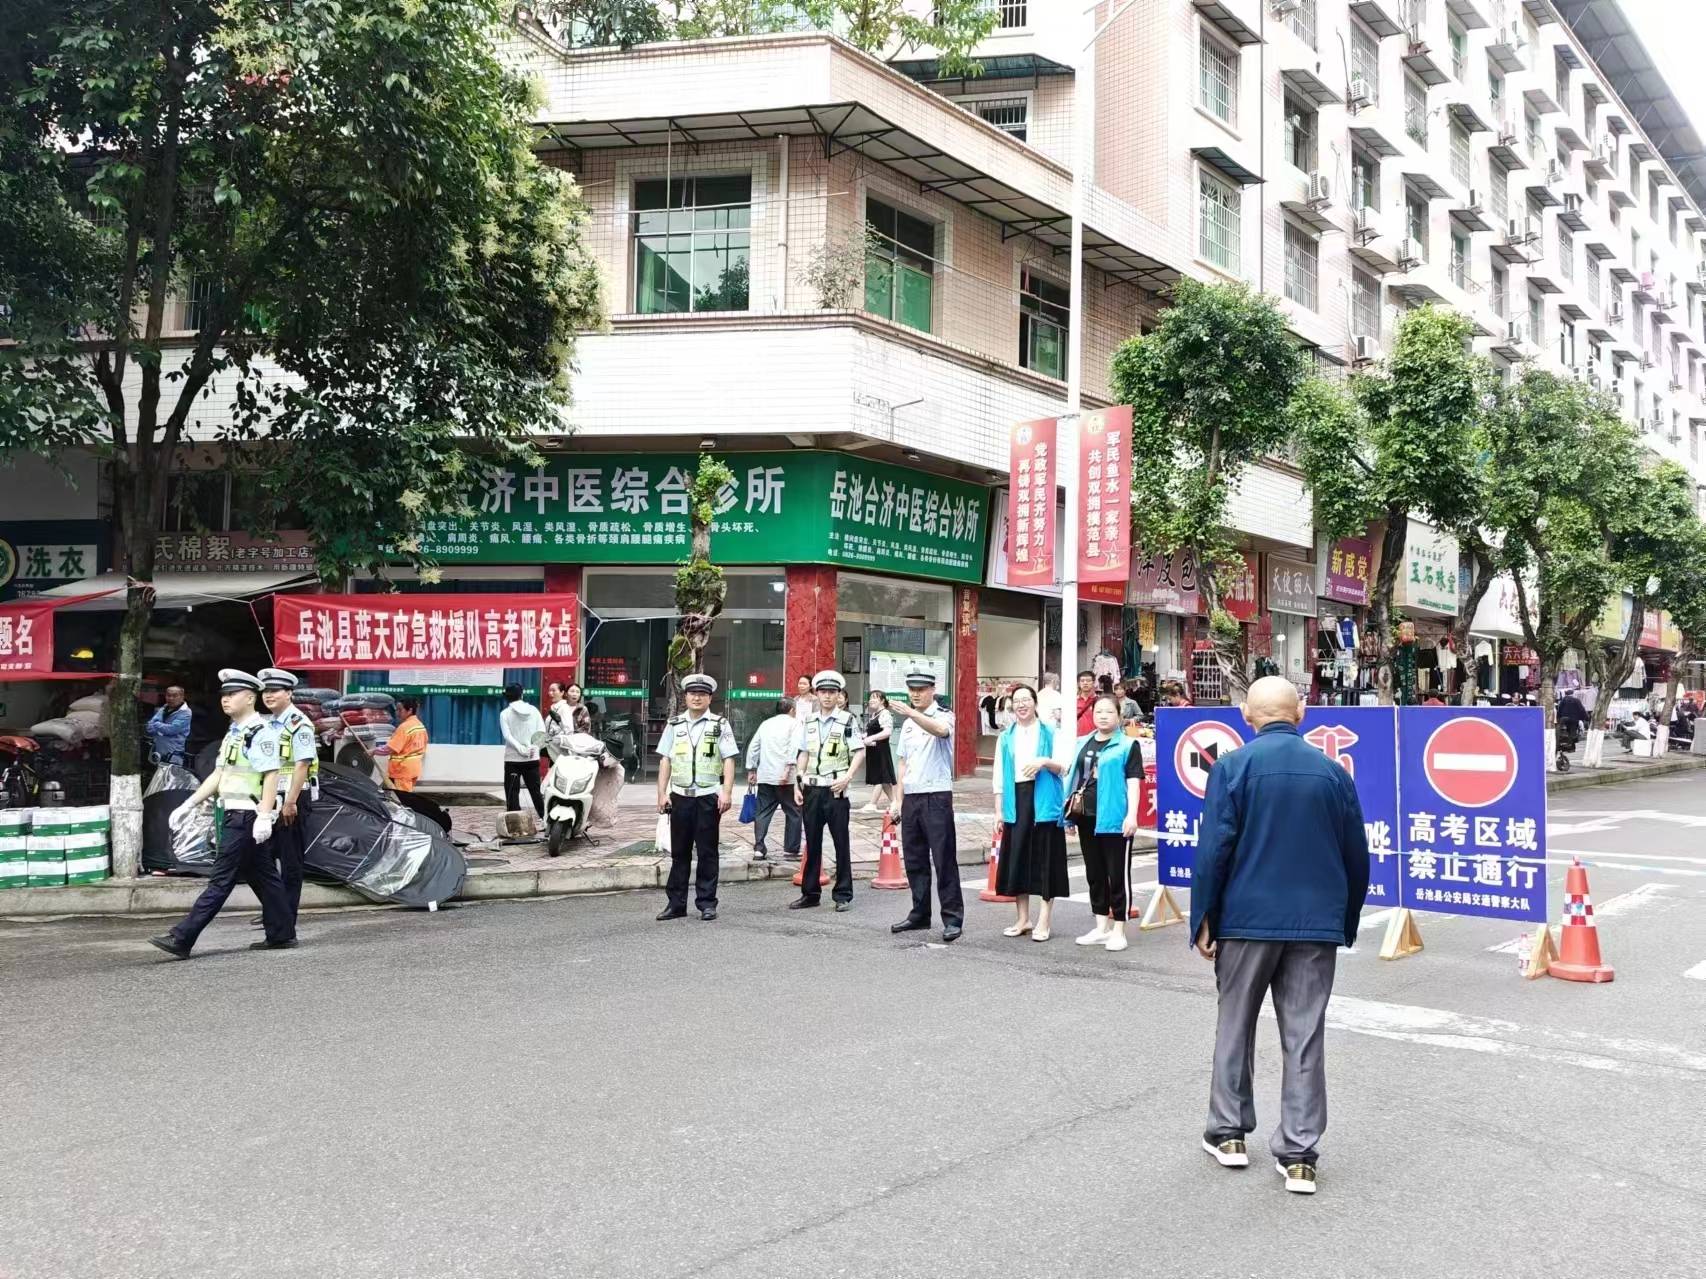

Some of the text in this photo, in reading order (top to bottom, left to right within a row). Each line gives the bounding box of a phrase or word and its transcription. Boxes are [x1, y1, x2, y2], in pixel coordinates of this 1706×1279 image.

[829, 470, 980, 543] 岳池合济中医综合诊所
[1033, 442, 1048, 547] 党政军民齐努力
[1086, 449, 1103, 558] 共创双拥模范县
[1104, 432, 1121, 541] 军民鱼水一家亲
[25, 547, 86, 577] 洗衣
[1331, 547, 1368, 581] 新感觉
[297, 608, 573, 661] 岳池县蓝天应急救援队高考服务点
[1409, 812, 1538, 852] 高考区域
[1409, 850, 1539, 889] 禁止通行
[1415, 888, 1531, 911] 岳池县公安局交通警察大队
